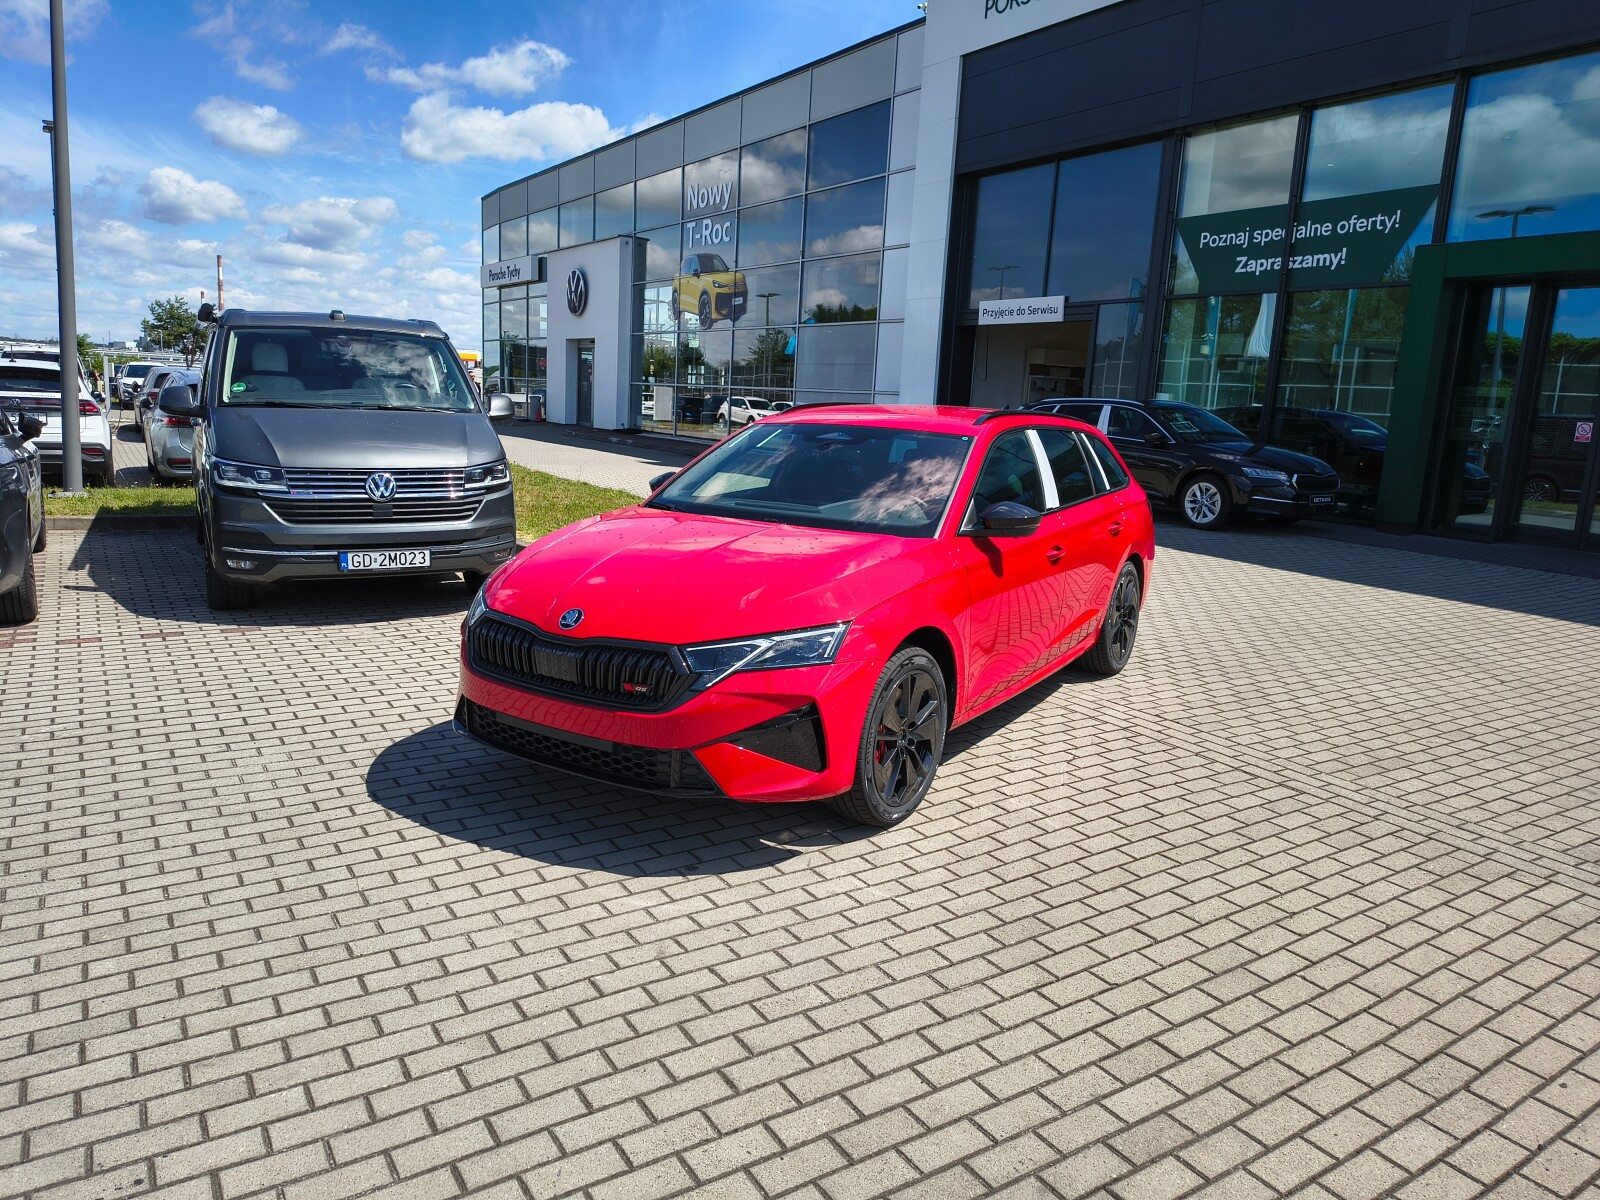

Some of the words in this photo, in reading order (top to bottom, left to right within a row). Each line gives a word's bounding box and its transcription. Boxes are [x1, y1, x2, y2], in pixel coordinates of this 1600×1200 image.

[687, 181, 734, 211] Nowy
[686, 218, 732, 249] T-Roc
[1199, 227, 1250, 249] Poznaj
[1336, 209, 1402, 234] oferty!
[488, 267, 506, 282] Porsche
[506, 264, 521, 282] Tychy
[1234, 247, 1348, 276] Zapraszamy!
[982, 307, 1015, 320] Przyjęcie
[1016, 305, 1026, 316] do
[1027, 304, 1059, 316] Serwisu
